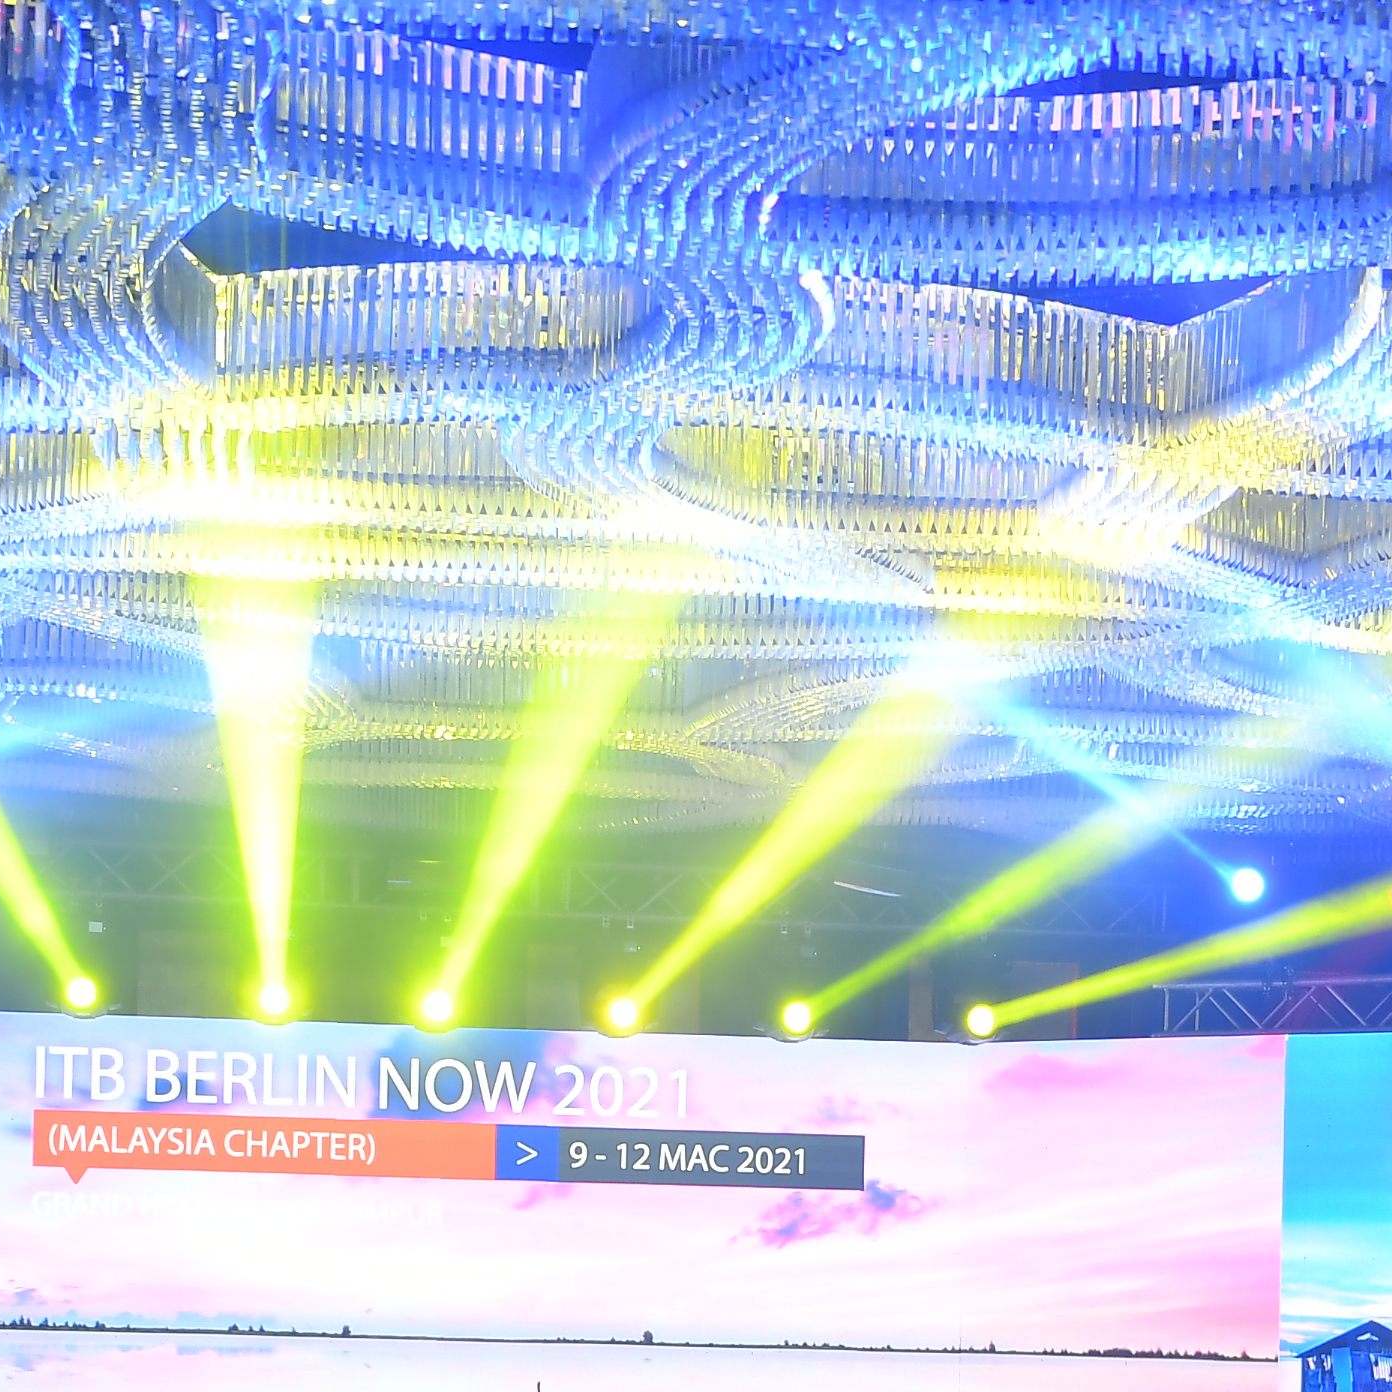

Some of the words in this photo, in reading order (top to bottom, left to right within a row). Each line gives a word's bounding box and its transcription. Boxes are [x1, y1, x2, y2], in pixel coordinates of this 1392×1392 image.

[35, 1046, 126, 1101] ITB
[146, 1049, 357, 1108] BERLIN
[378, 1056, 538, 1114] NOW
[552, 1064, 689, 1118] 2021
[48, 1123, 216, 1156] (MALAYSIA
[223, 1130, 376, 1165] CHAPTER)
[568, 1141, 588, 1169] 9
[617, 1142, 651, 1170] 12
[658, 1143, 729, 1173] MAC
[737, 1146, 806, 1175] 2021
